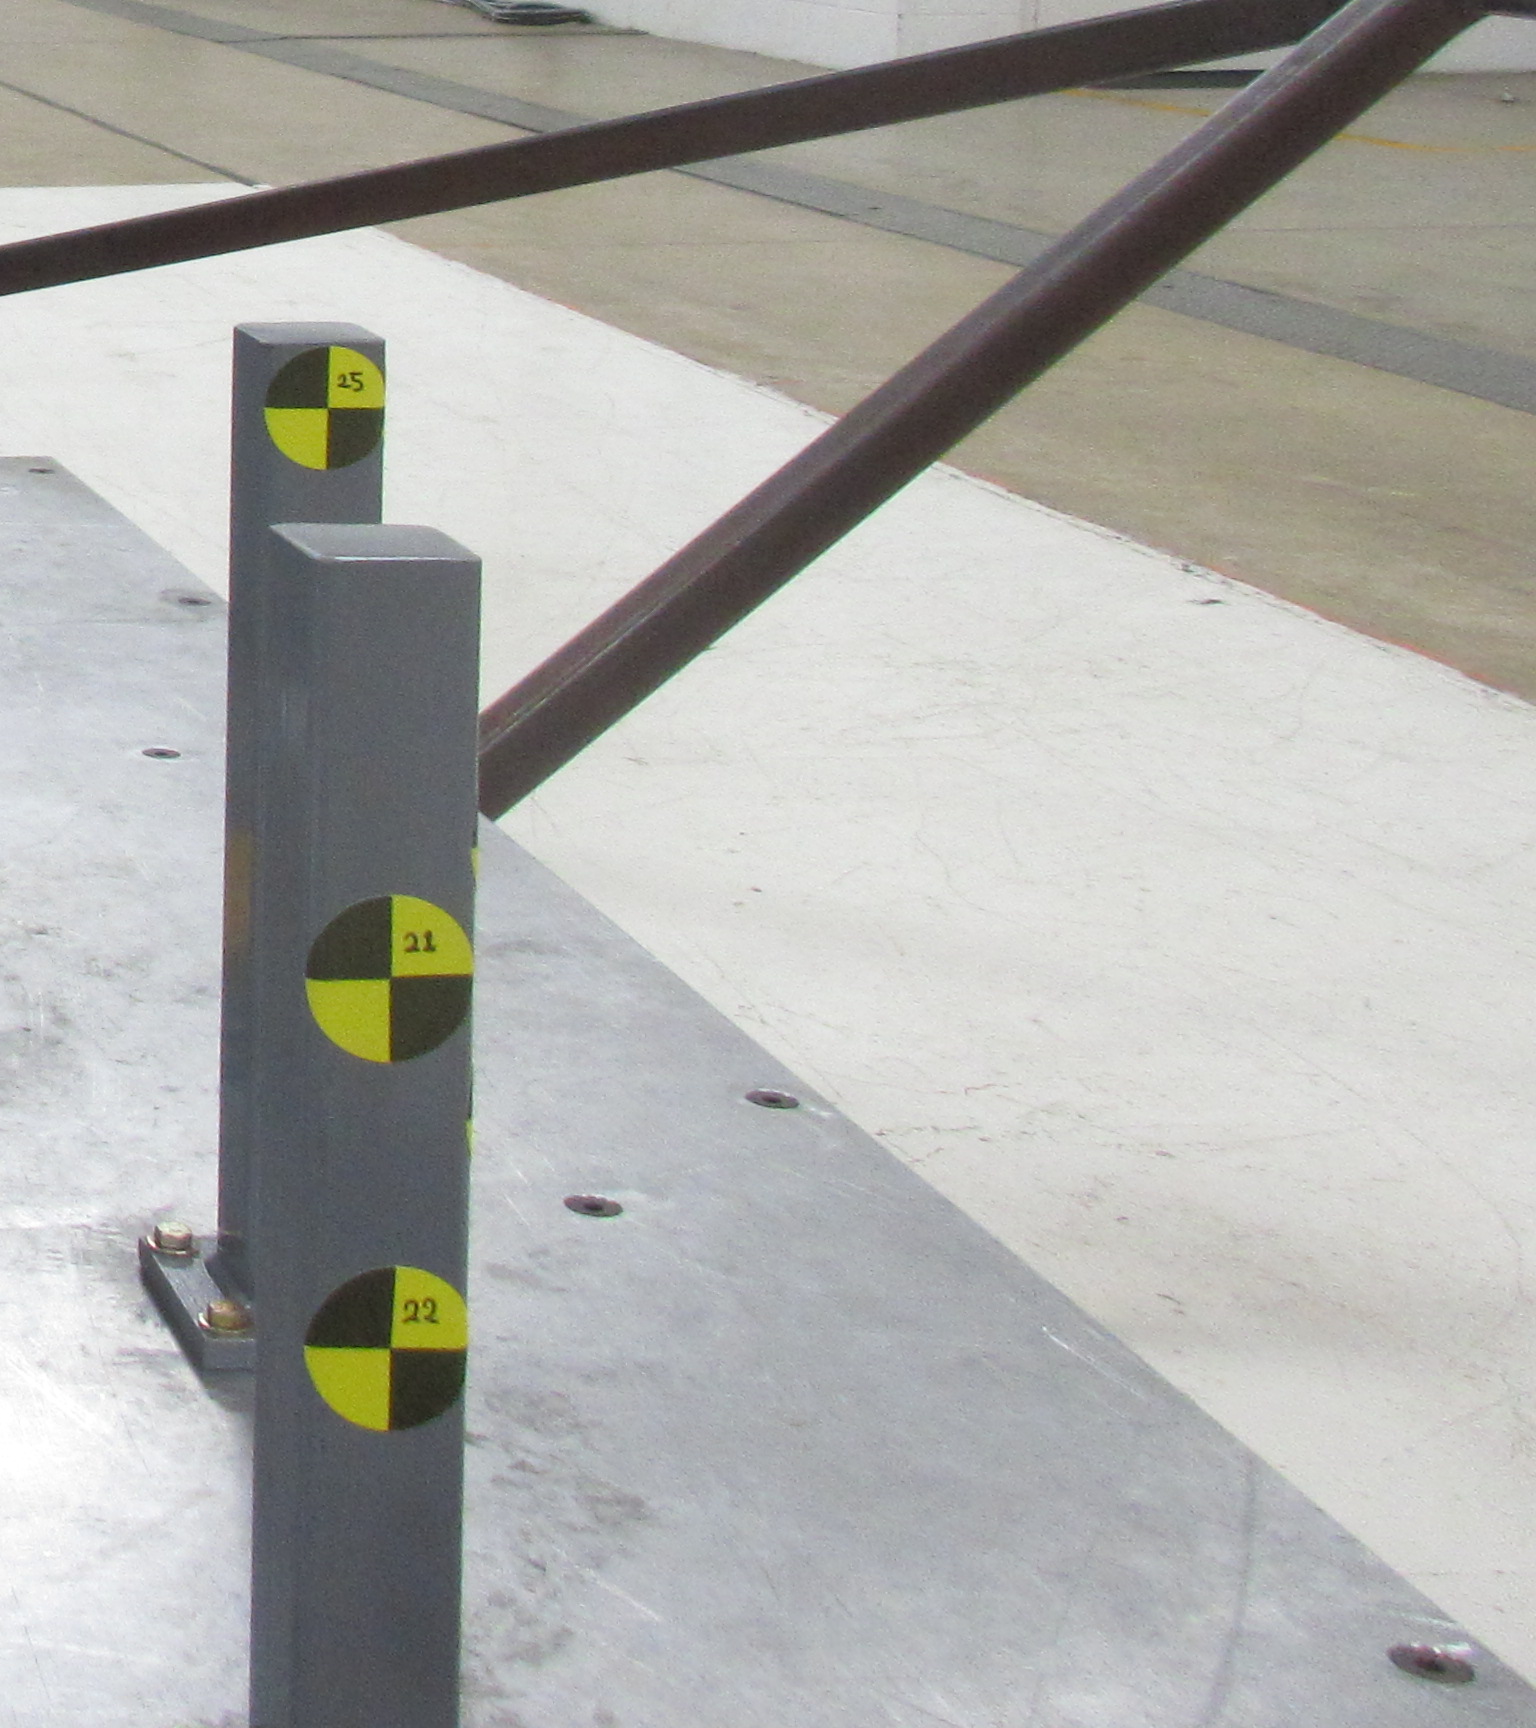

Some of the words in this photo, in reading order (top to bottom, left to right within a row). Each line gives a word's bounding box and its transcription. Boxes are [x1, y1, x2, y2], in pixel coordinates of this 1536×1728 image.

[336, 371, 365, 392] 25
[402, 930, 438, 954] 21
[401, 1297, 441, 1325] 22
